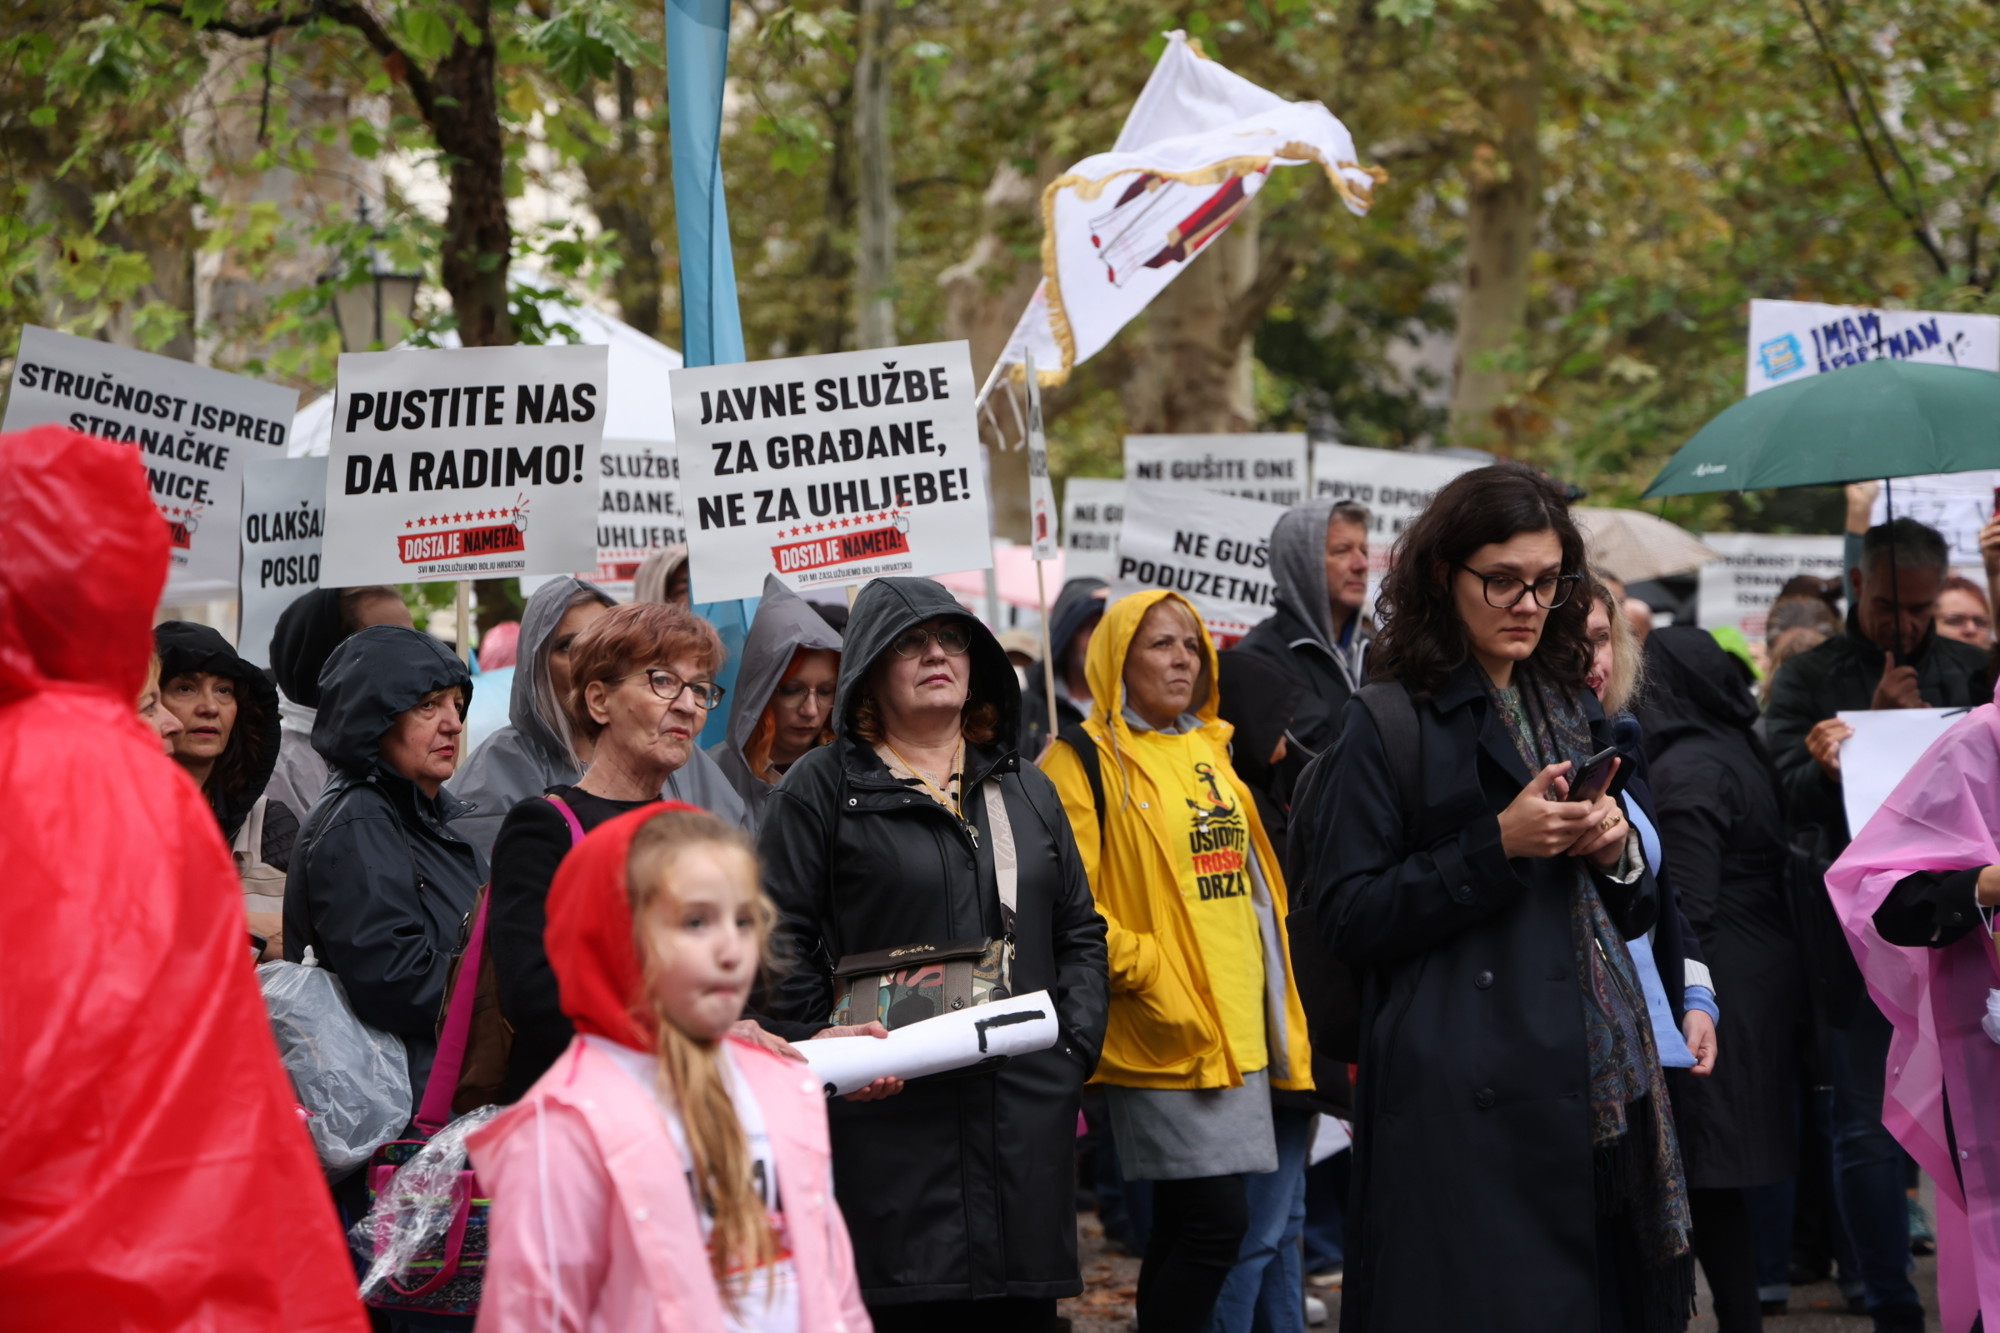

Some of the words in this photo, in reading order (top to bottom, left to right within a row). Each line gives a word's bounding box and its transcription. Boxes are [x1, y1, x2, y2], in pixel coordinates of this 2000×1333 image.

[19, 363, 188, 422] STRUČNOST
[191, 403, 285, 446] ISPRED
[346, 385, 505, 433] PUSTITE
[516, 383, 597, 424] NAS
[700, 381, 806, 425] JAVNE
[815, 361, 949, 412] SLUŽBE
[712, 440, 759, 476] ZA
[766, 420, 947, 470] GRAĐANE,
[143, 465, 214, 505] NICE.
[345, 453, 398, 495] DA
[409, 444, 584, 491] RADIMO!
[1136, 460, 1164, 481] NE
[698, 493, 746, 530] NE
[754, 488, 800, 523] ZA
[808, 467, 971, 517] UHLJEBE!
[404, 535, 445, 561] DOSTA
[447, 533, 460, 555] JE
[464, 527, 518, 553] NAMETA!
[780, 543, 823, 571] DOSTA
[826, 539, 840, 562] JE
[842, 529, 902, 559] NAMETA!
[1173, 530, 1209, 558] NE
[261, 553, 321, 589] POSLO
[418, 566, 428, 574] SVI
[429, 565, 436, 573] MI
[437, 562, 478, 573] ZASLUŽUJEMO
[479, 561, 496, 570] BOLJU
[497, 560, 525, 569] HRVATSKU
[798, 574, 808, 583] SVI
[809, 573, 817, 581] MI
[819, 568, 861, 580] ZASLUŽUJEMO
[862, 565, 880, 575] BOLJU
[881, 561, 912, 572] HRVATSKU
